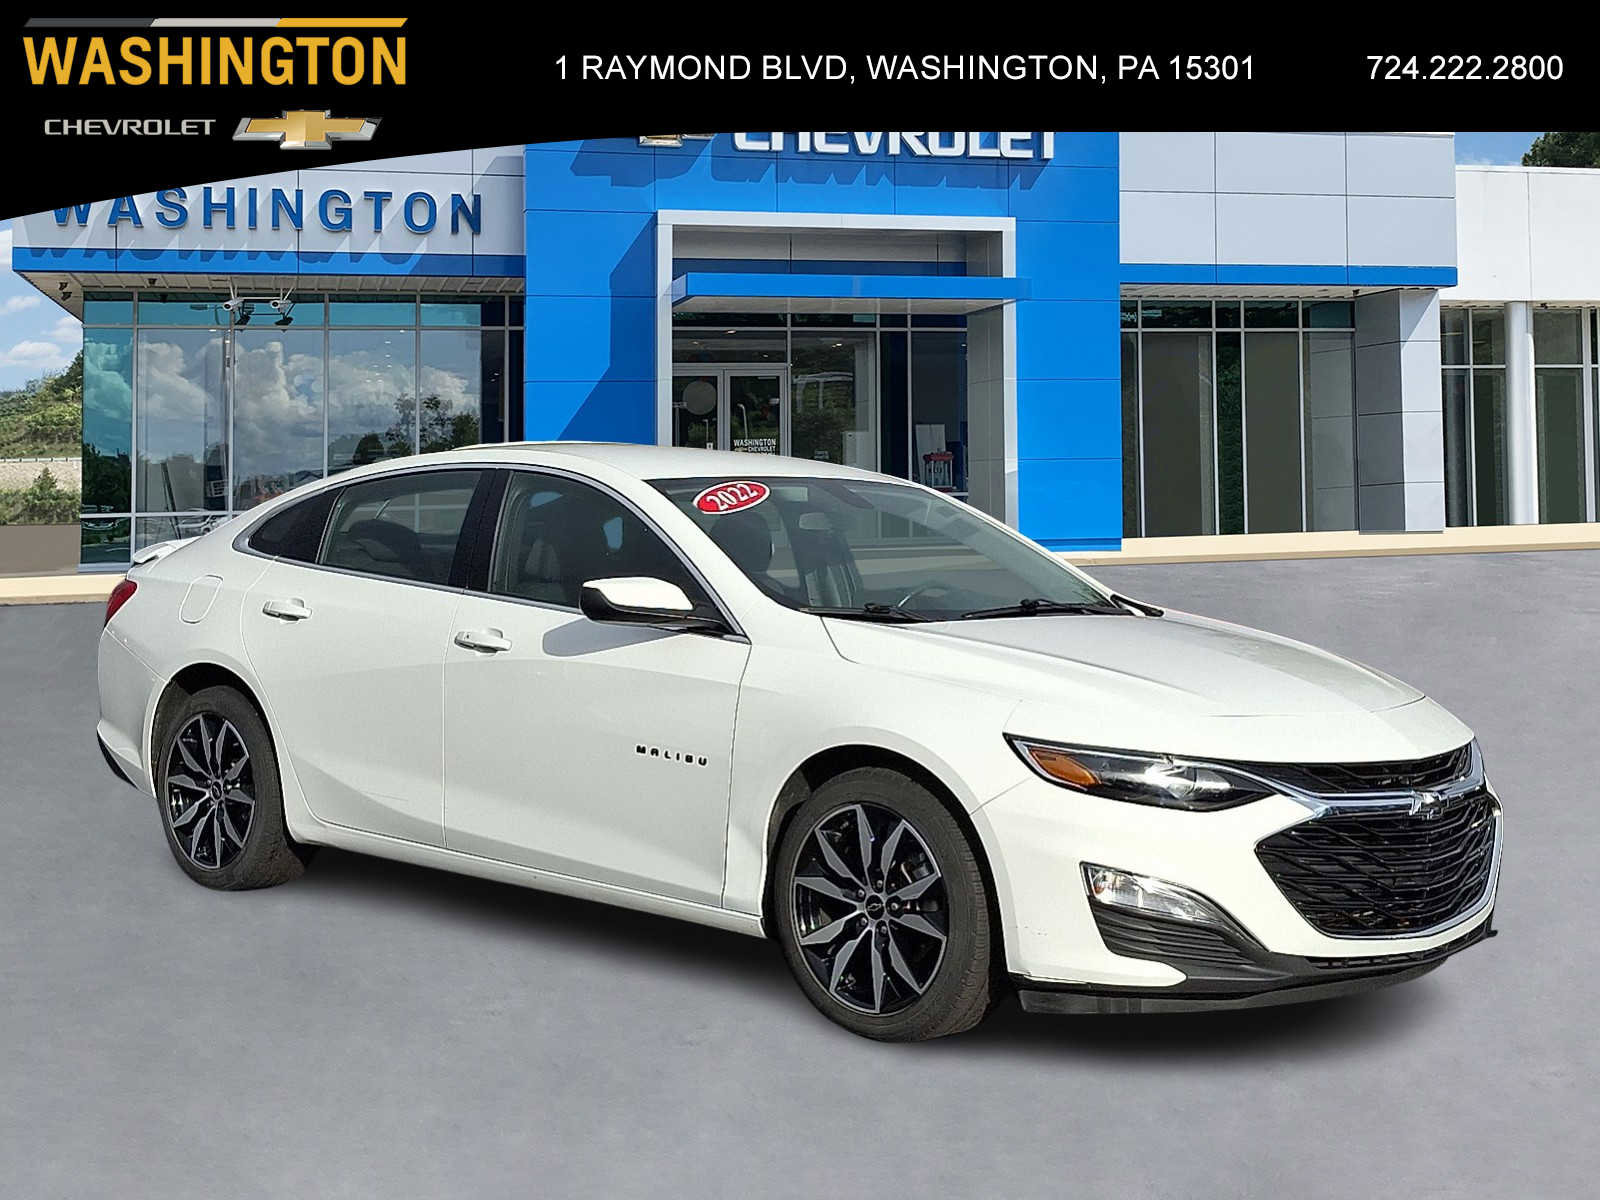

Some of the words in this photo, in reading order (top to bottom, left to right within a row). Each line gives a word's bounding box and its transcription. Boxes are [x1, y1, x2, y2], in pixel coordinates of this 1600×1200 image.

[733, 438, 777, 447] WASHINGTON
[705, 483, 759, 511] 2022
[636, 745, 707, 766] MALIBU
